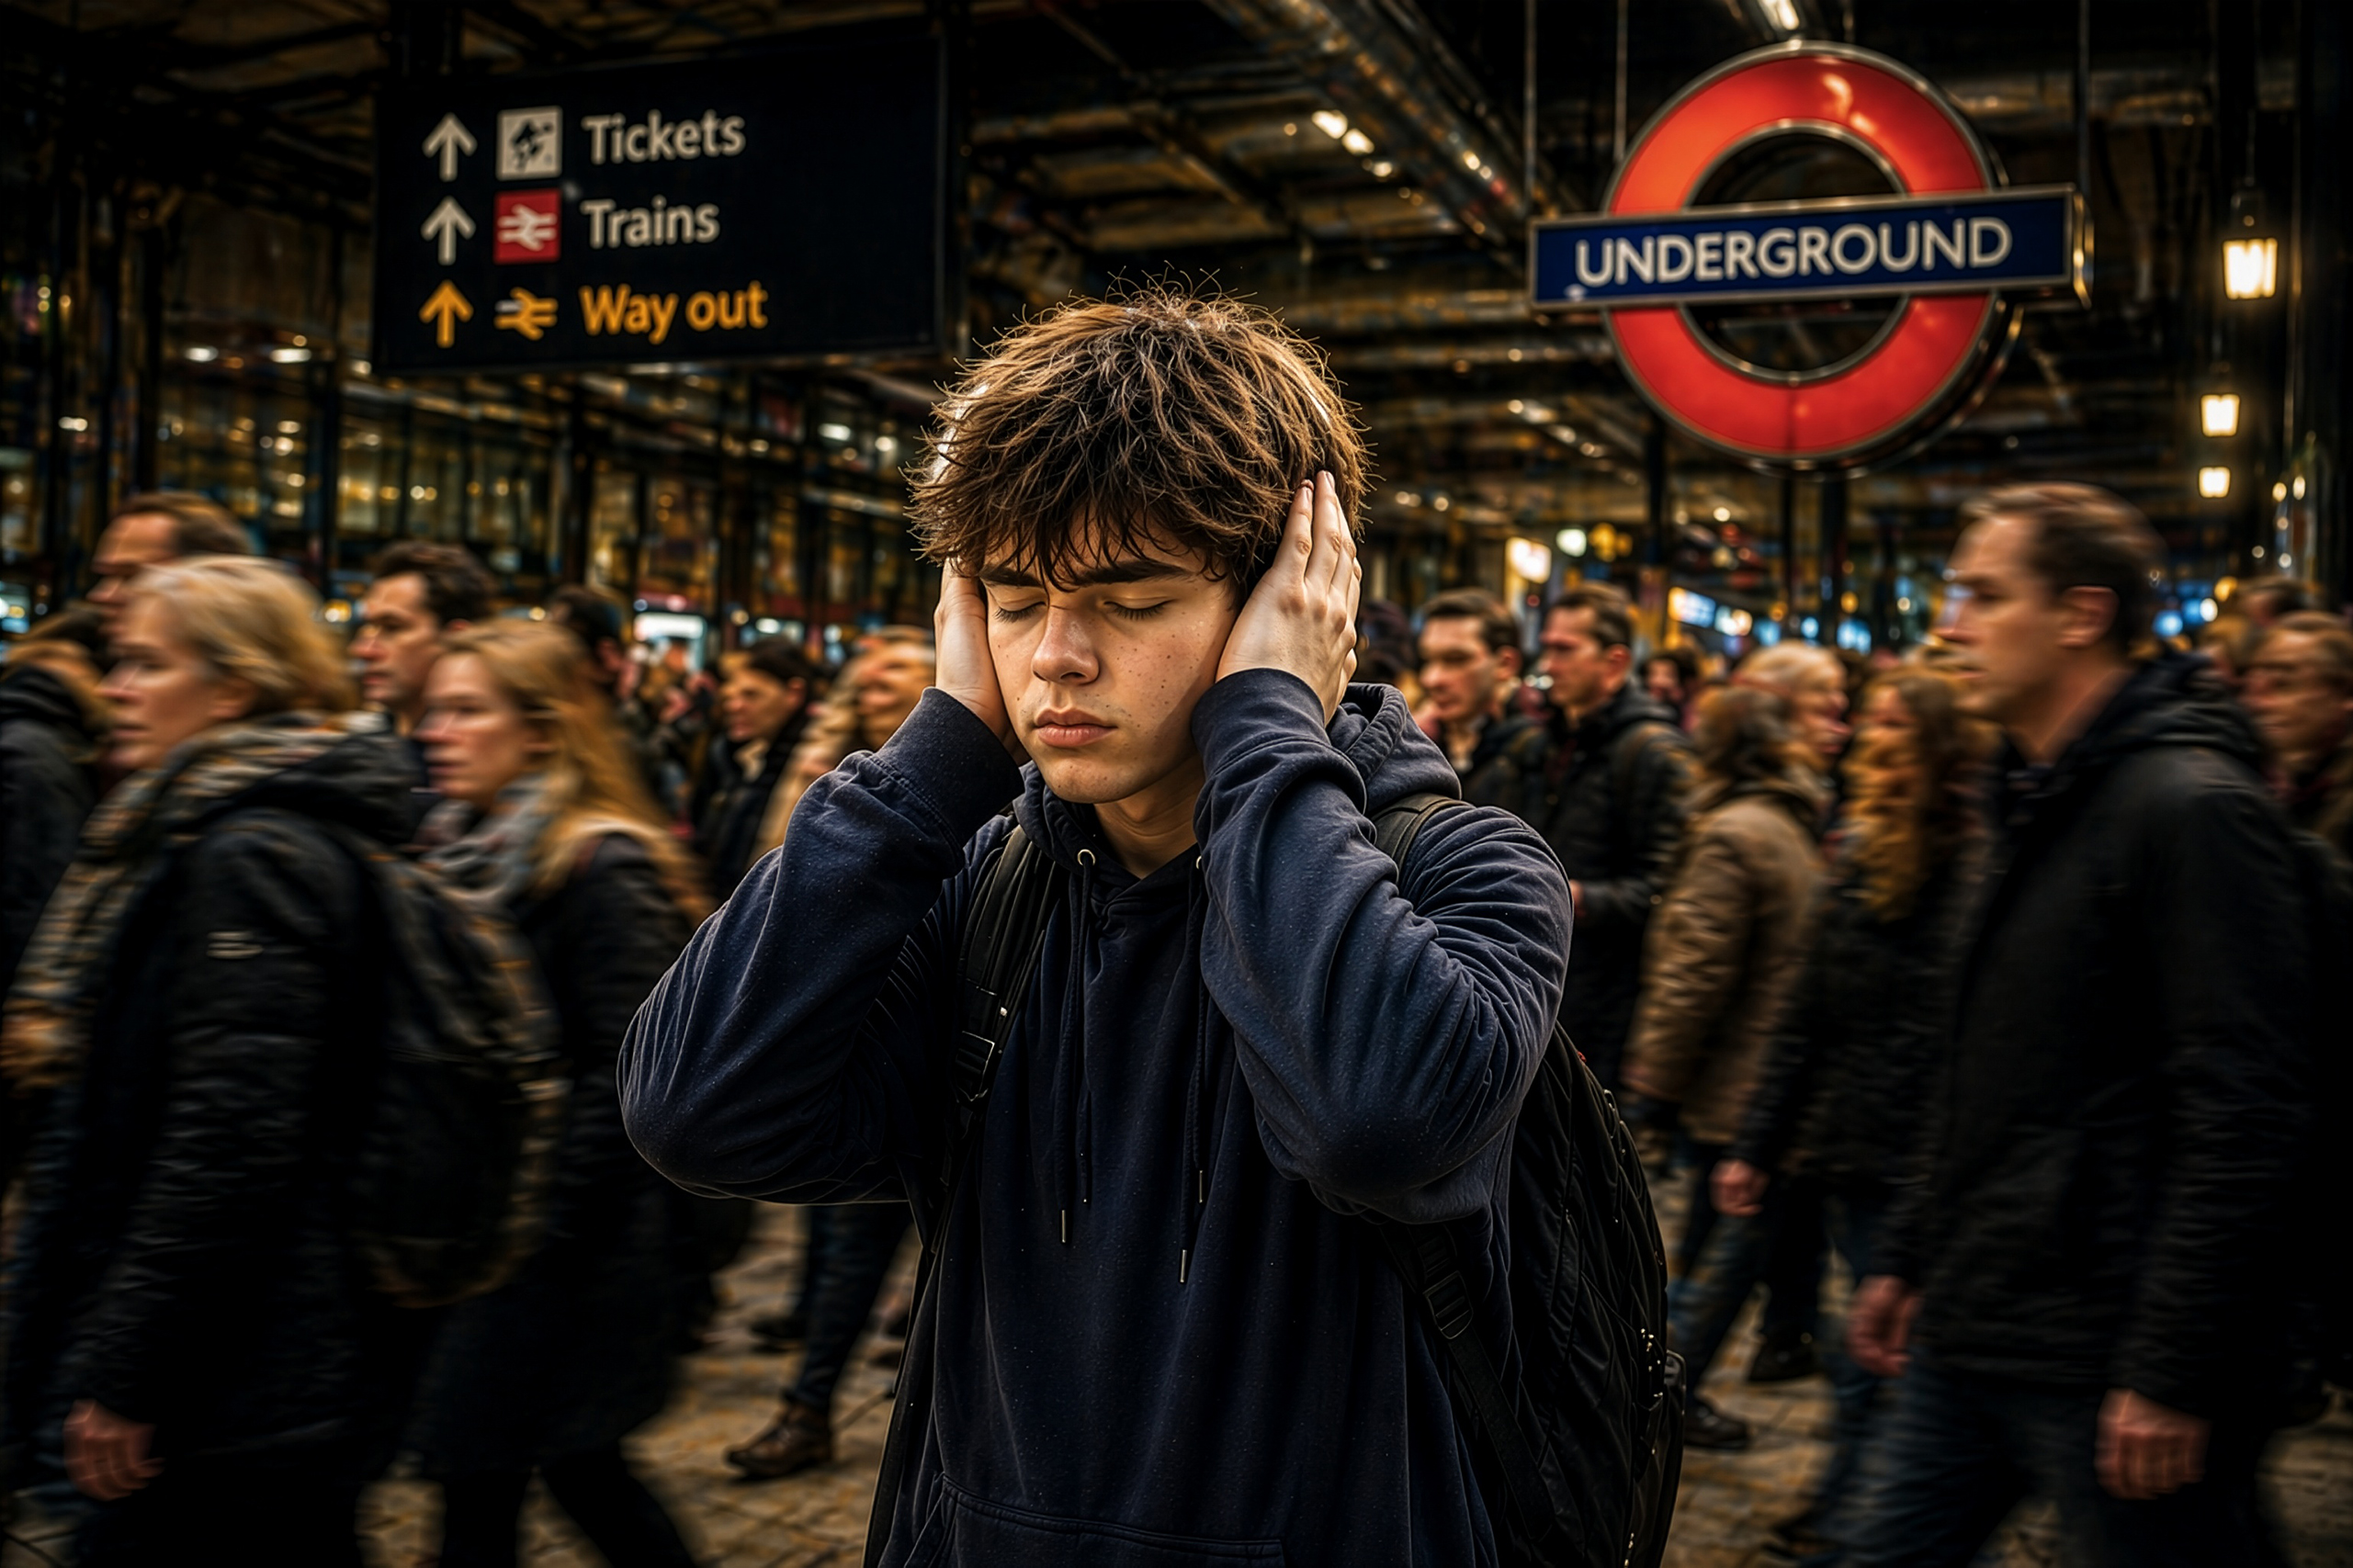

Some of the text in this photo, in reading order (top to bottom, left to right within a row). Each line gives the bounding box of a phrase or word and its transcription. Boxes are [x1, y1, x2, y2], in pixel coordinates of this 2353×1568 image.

[582, 111, 745, 164] Tickets
[582, 195, 719, 249] Trains
[1577, 218, 2012, 286] UNDERGROUND
[580, 281, 768, 344] Way out
